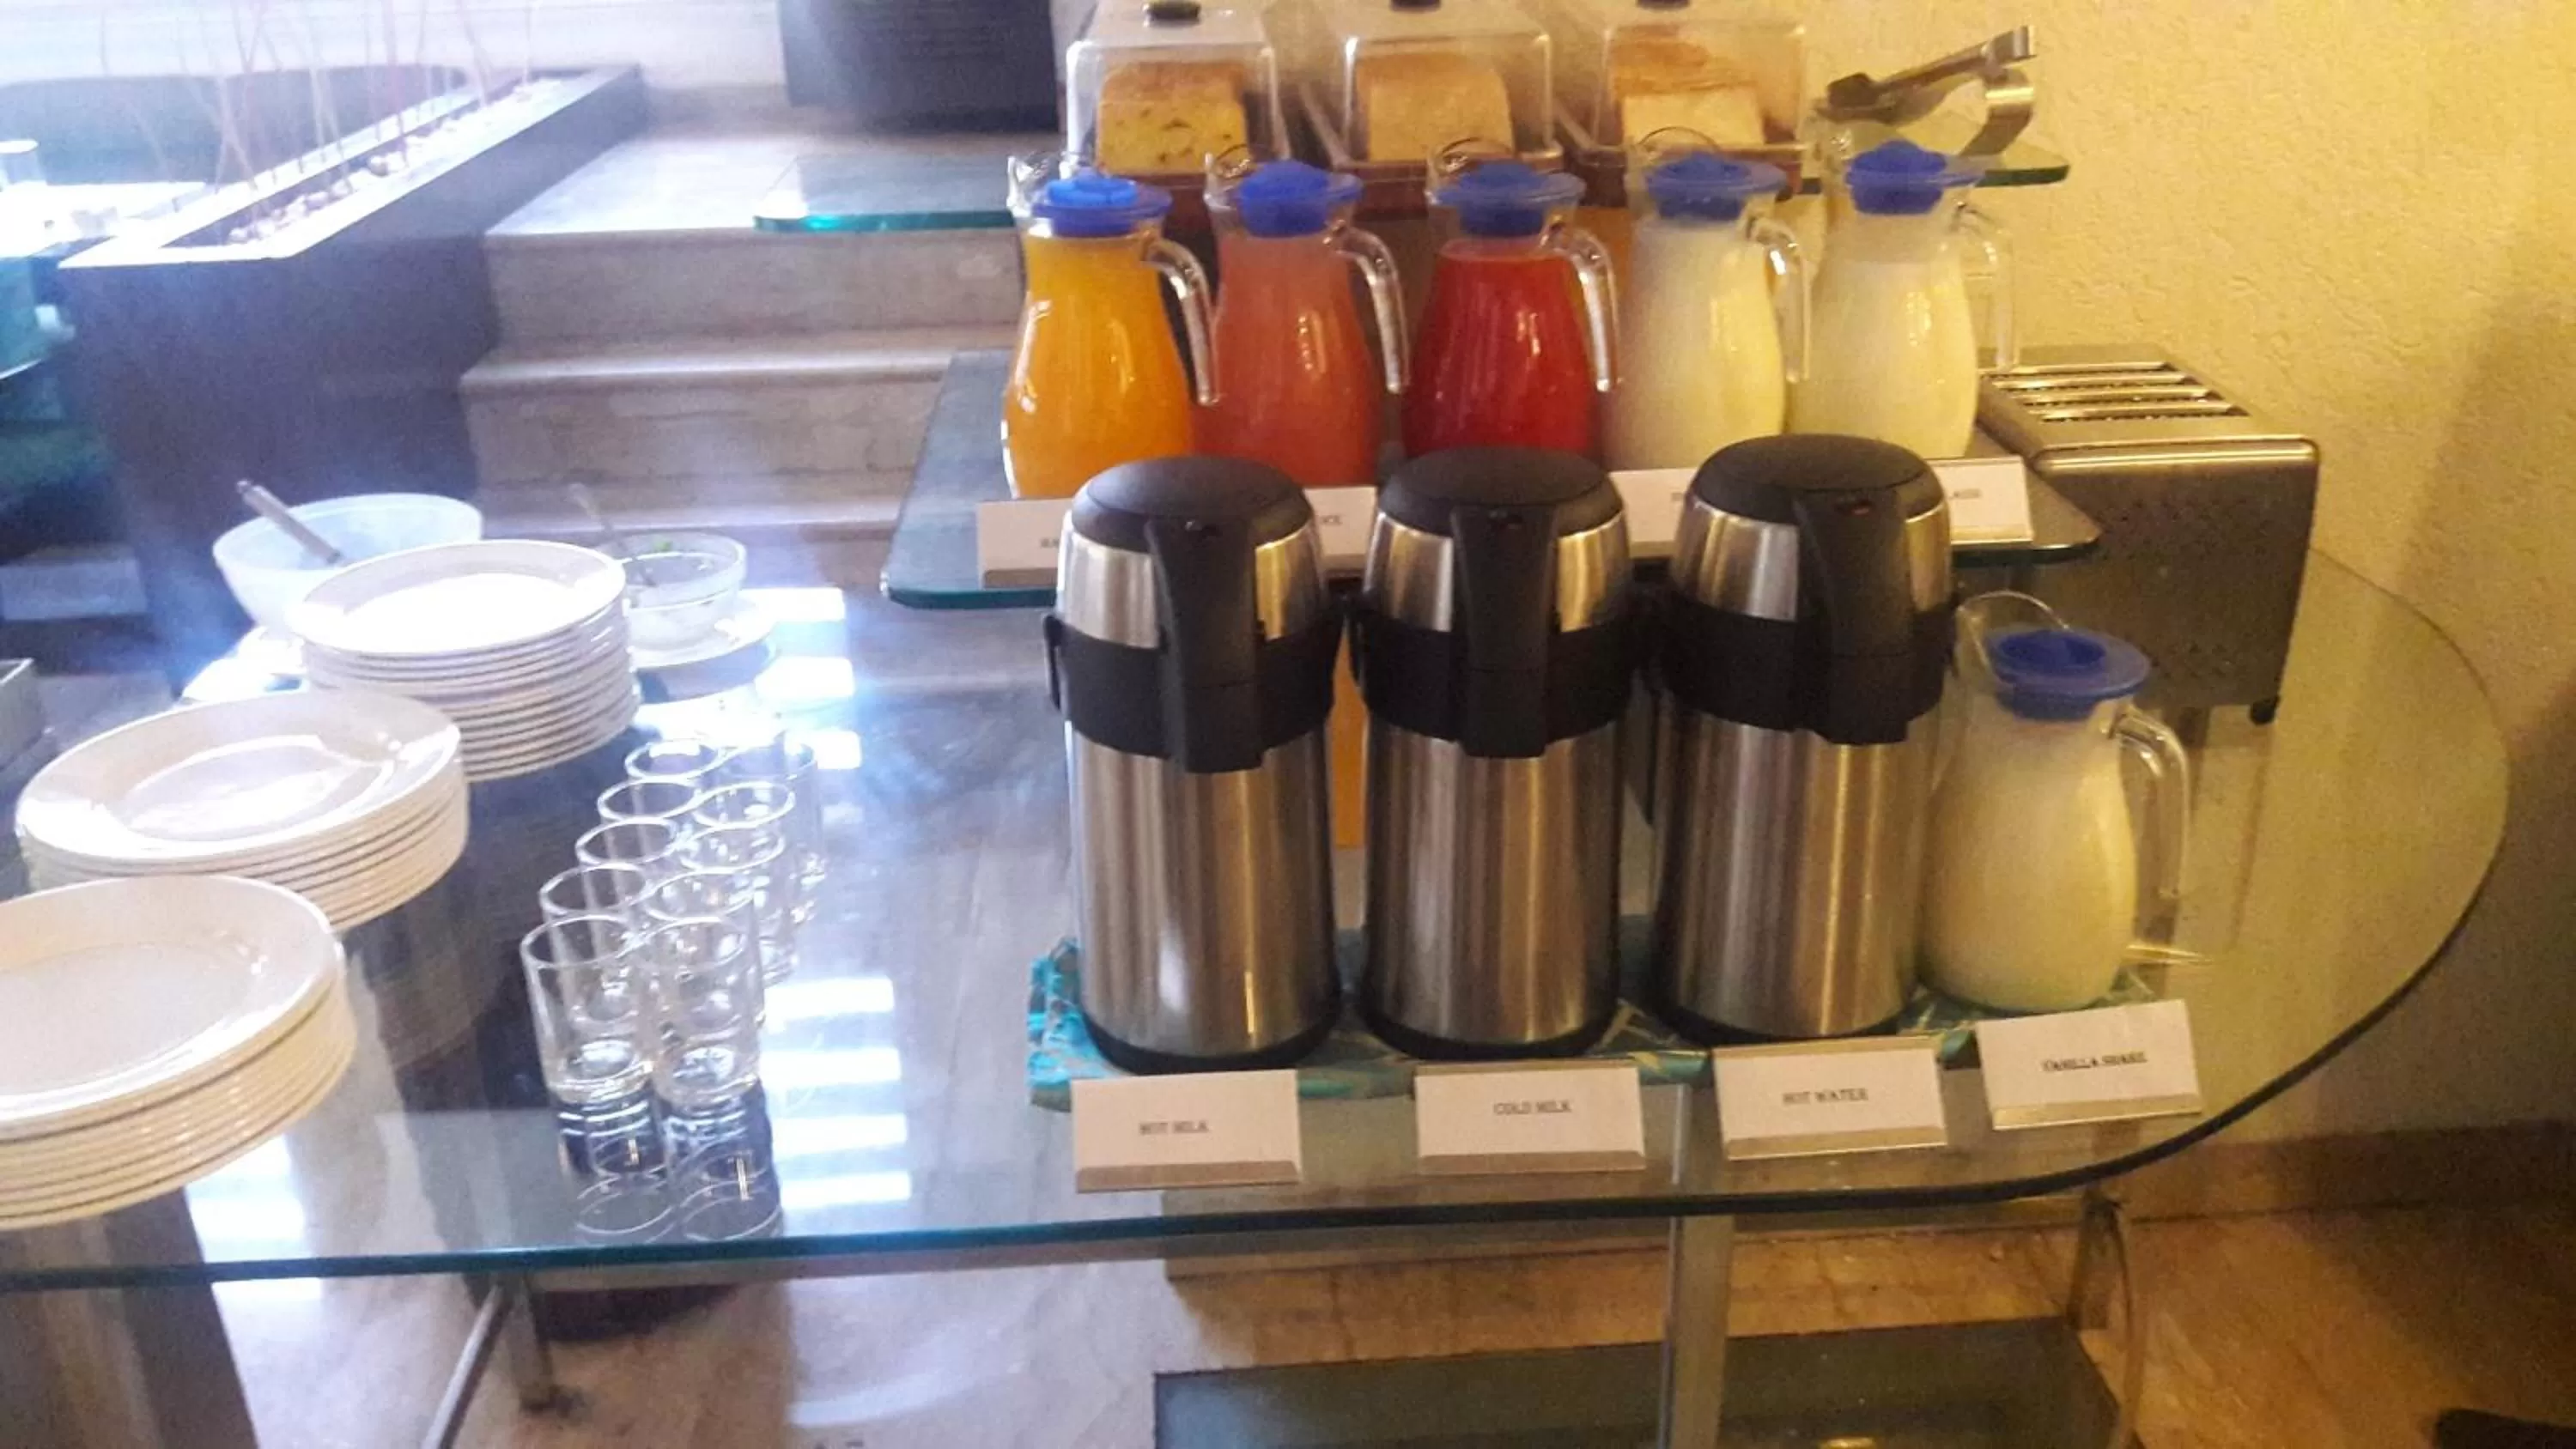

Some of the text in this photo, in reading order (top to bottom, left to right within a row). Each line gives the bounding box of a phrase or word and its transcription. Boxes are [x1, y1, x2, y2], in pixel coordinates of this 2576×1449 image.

[2041, 1058, 2099, 1071] VANILLA
[1783, 1088, 1868, 1106] HOT WATER
[1493, 1099, 1572, 1115] COLD MILK
[1139, 1119, 1210, 1135] HOT MILK
